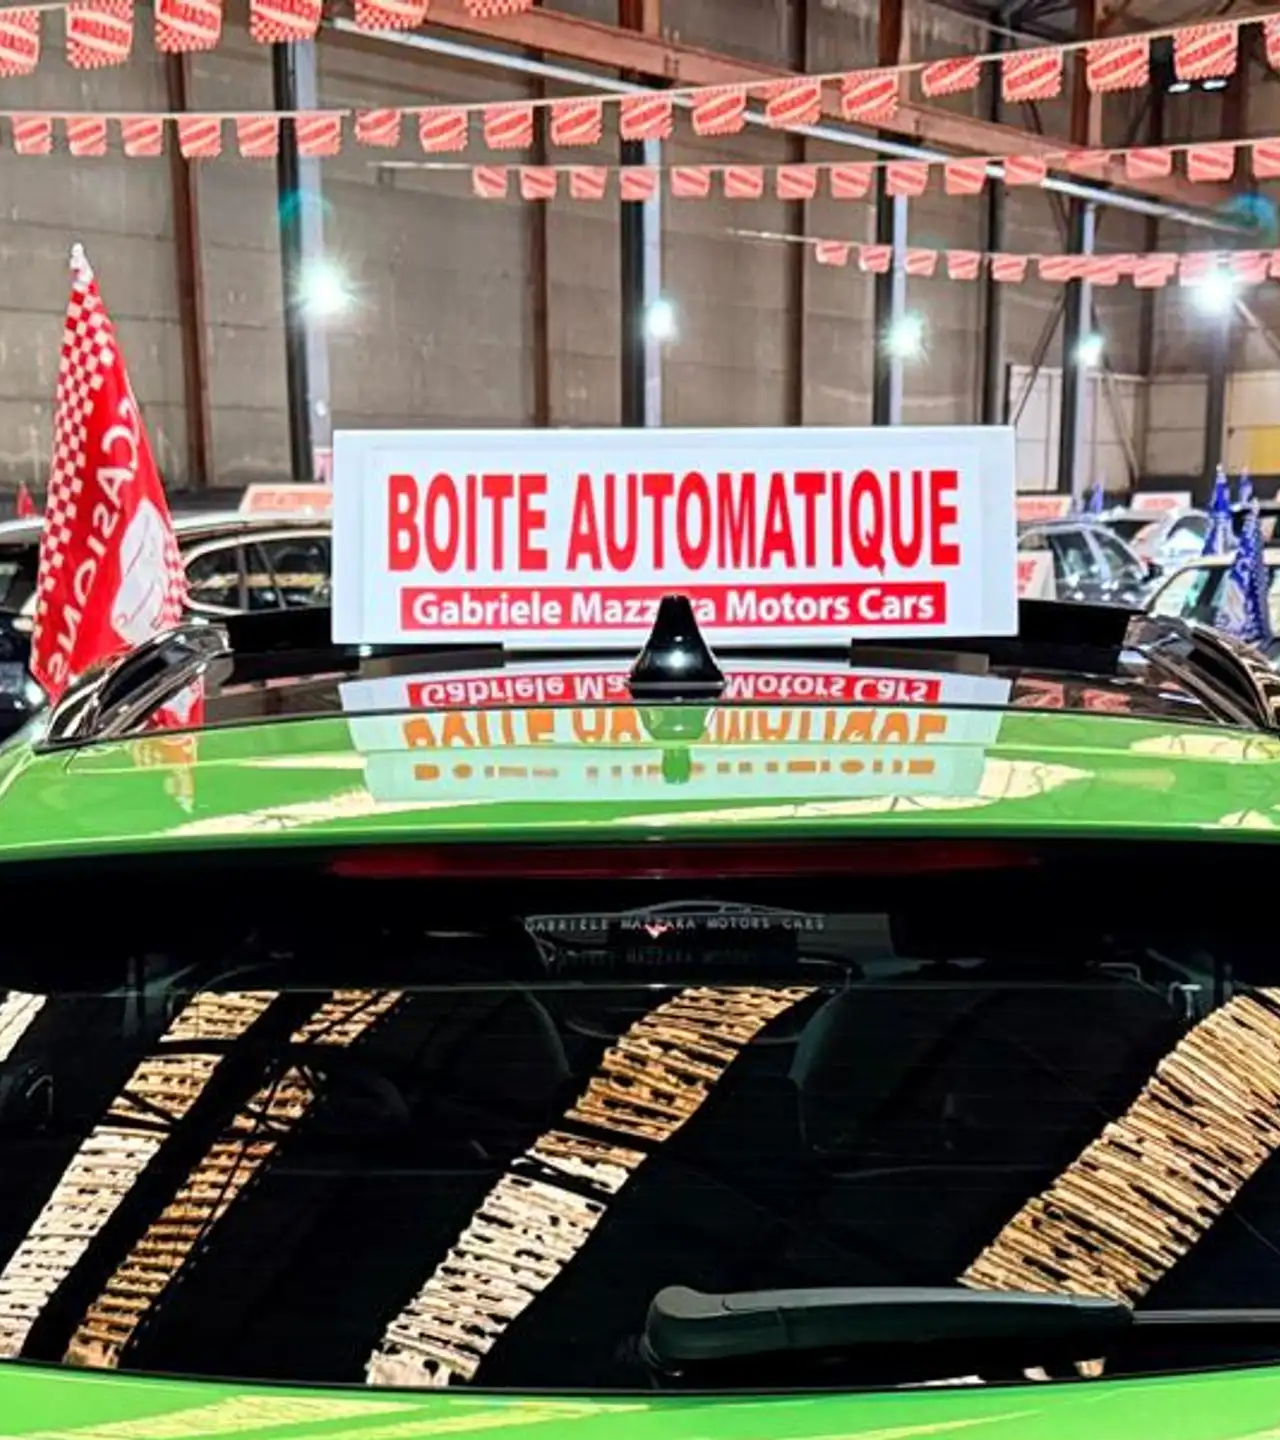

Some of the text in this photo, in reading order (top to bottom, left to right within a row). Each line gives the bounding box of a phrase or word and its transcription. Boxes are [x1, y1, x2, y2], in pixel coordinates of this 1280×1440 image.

[387, 470, 961, 577] BOITE AUTOMATIQUE
[413, 587, 936, 626] Gabriele Mazza Motors Cars
